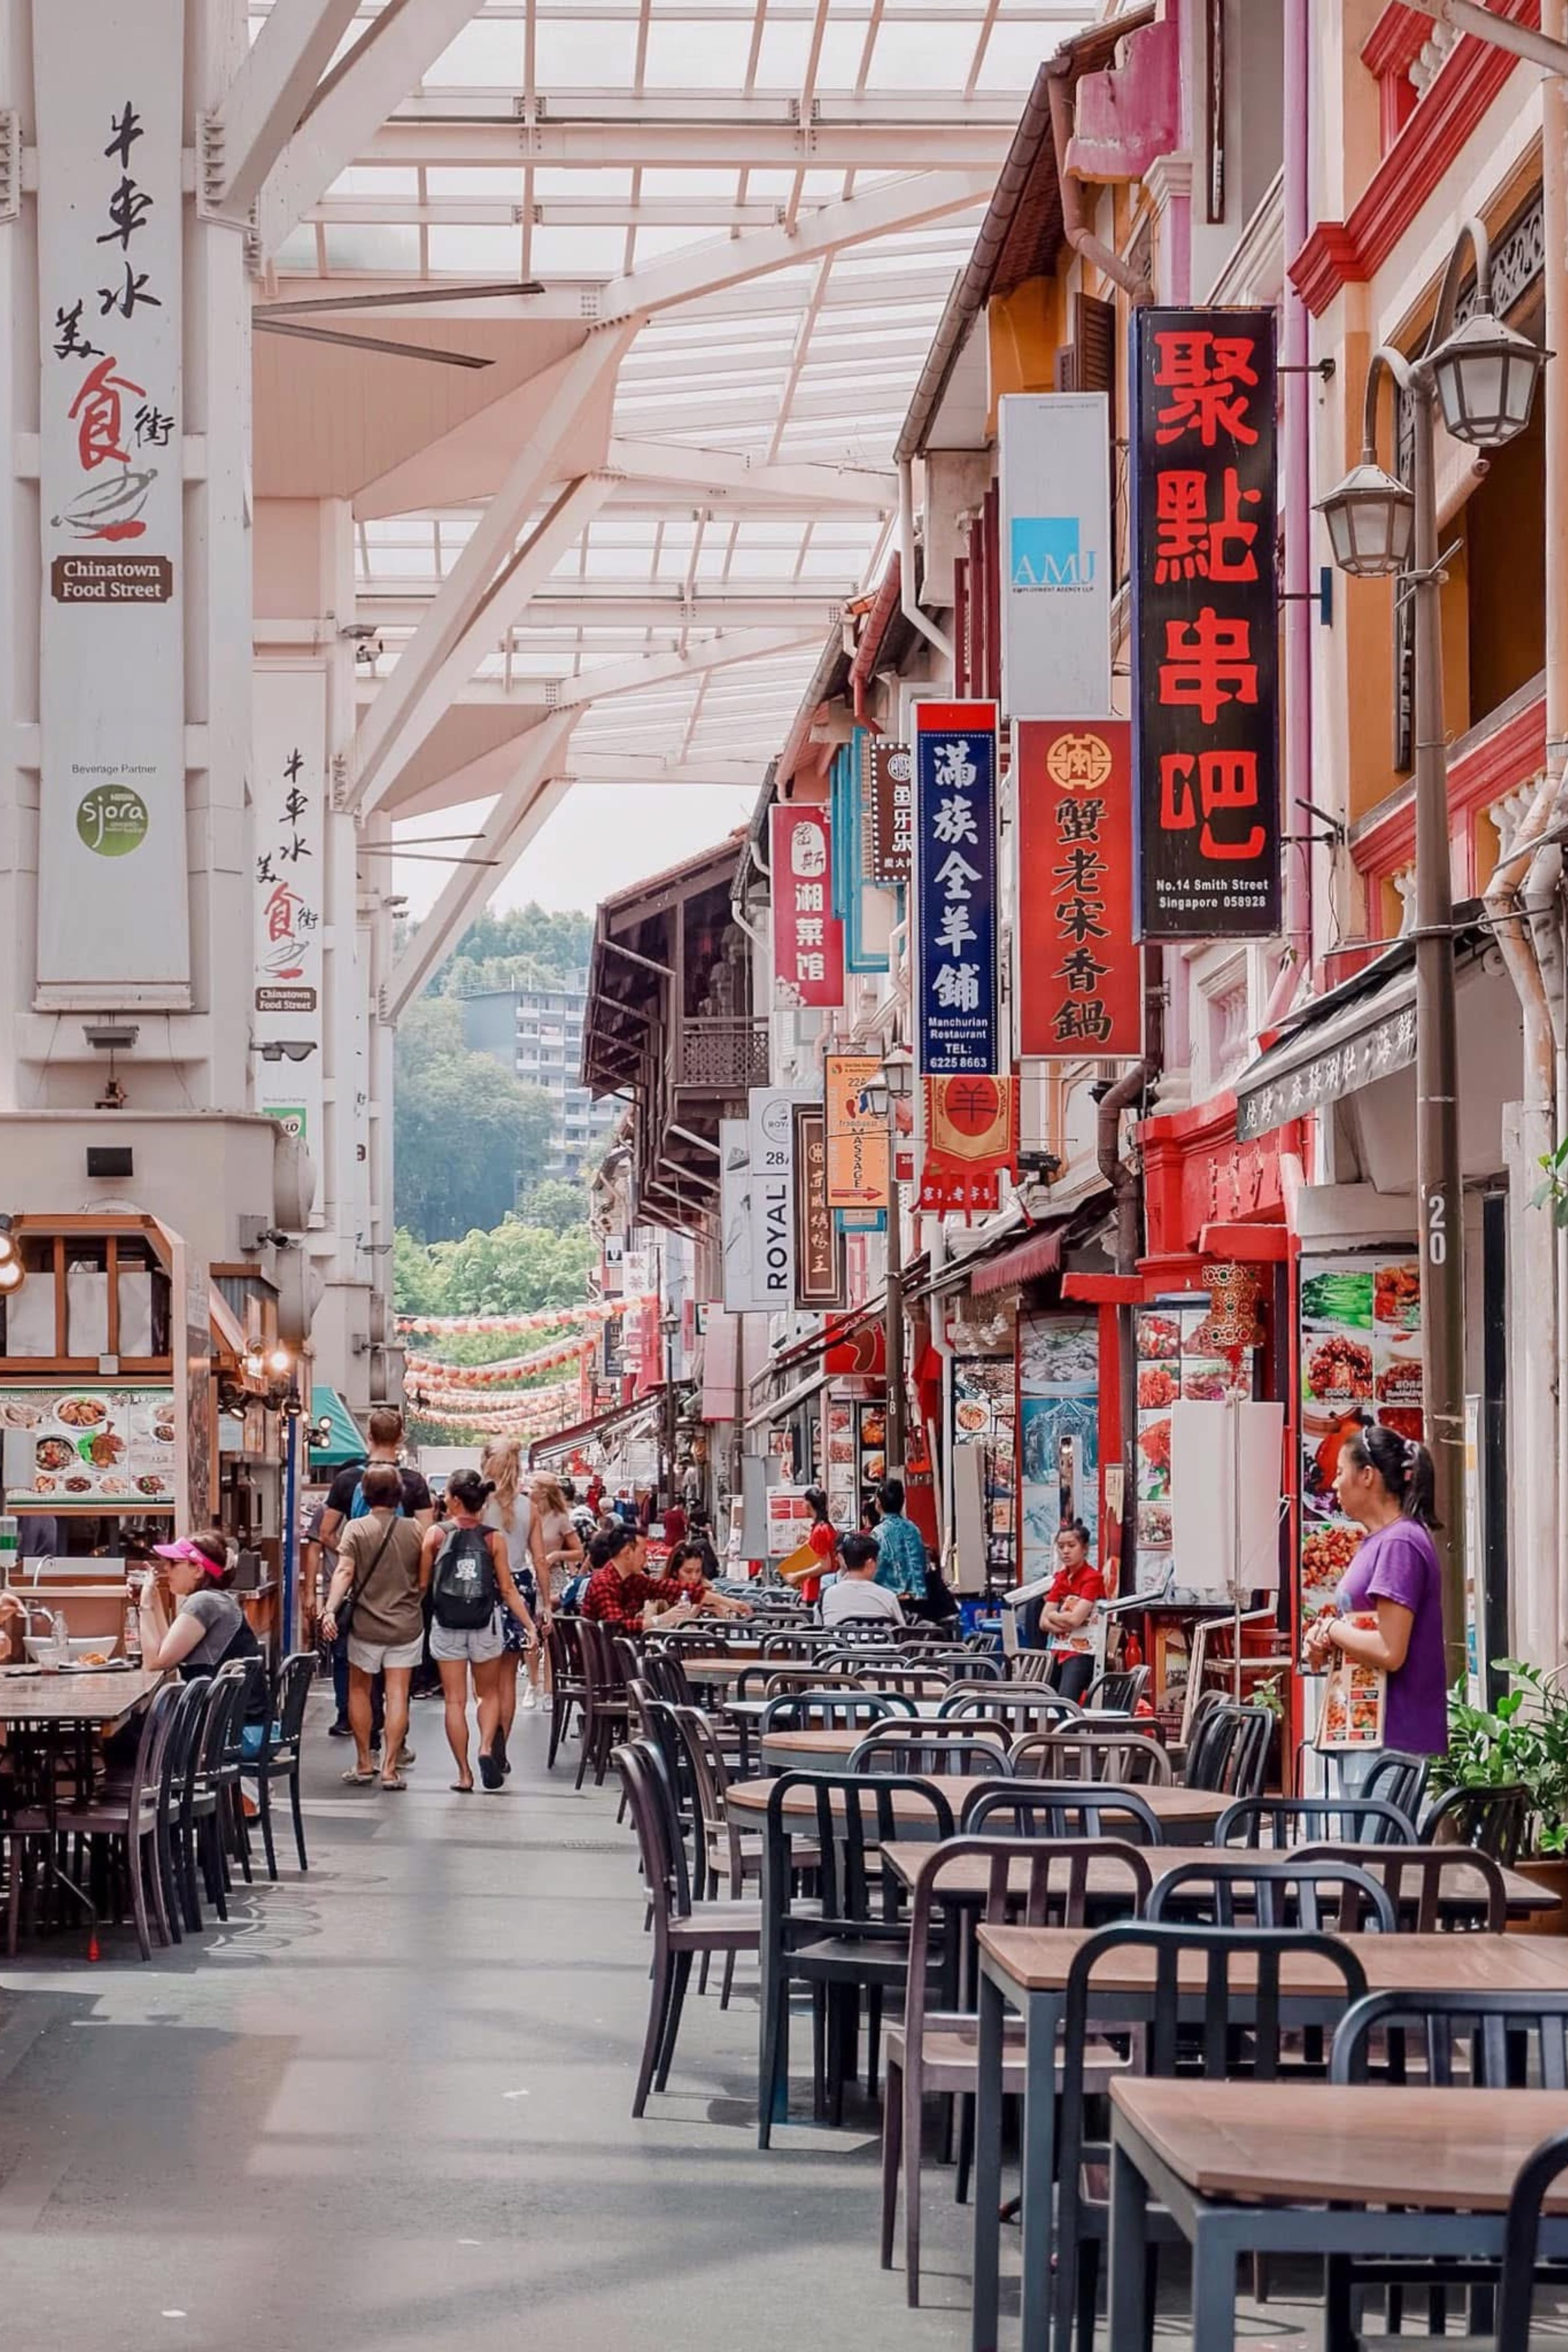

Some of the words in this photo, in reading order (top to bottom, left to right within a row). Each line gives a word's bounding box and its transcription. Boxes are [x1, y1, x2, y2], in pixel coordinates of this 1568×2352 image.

[64, 561, 161, 577] Chinatown
[1012, 550, 1097, 584] AMJ
[63, 581, 106, 597] Food
[110, 581, 161, 597] Street
[1154, 330, 1266, 859] 聚點串吧
[72, 764, 119, 775] Beverage
[121, 764, 157, 773] Partner
[82, 795, 145, 848] sjora
[1156, 879, 1190, 891] No.14
[1194, 879, 1228, 890] Smith
[1232, 879, 1269, 890] Street
[1159, 897, 1218, 910] Singapore
[1223, 896, 1266, 907] 058928
[1050, 797, 1113, 1043] 蟹老宋香鍋
[795, 883, 824, 981] 湘菜馆
[260, 988, 310, 998] Chinatown
[260, 1000, 282, 1009] Food
[283, 1000, 311, 1009] Street
[928, 1017, 988, 1027] Manchurian
[930, 1029, 987, 1039] Restaurant
[945, 1043, 971, 1054] TEL:
[930, 1057, 958, 1068] 6225
[960, 1057, 987, 1068] 8663
[852, 1128, 864, 1188] MASSAGE
[766, 1184, 788, 1290] ROYAL
[1428, 1195, 1446, 1264] 20
[888, 1385, 896, 1415] 18
